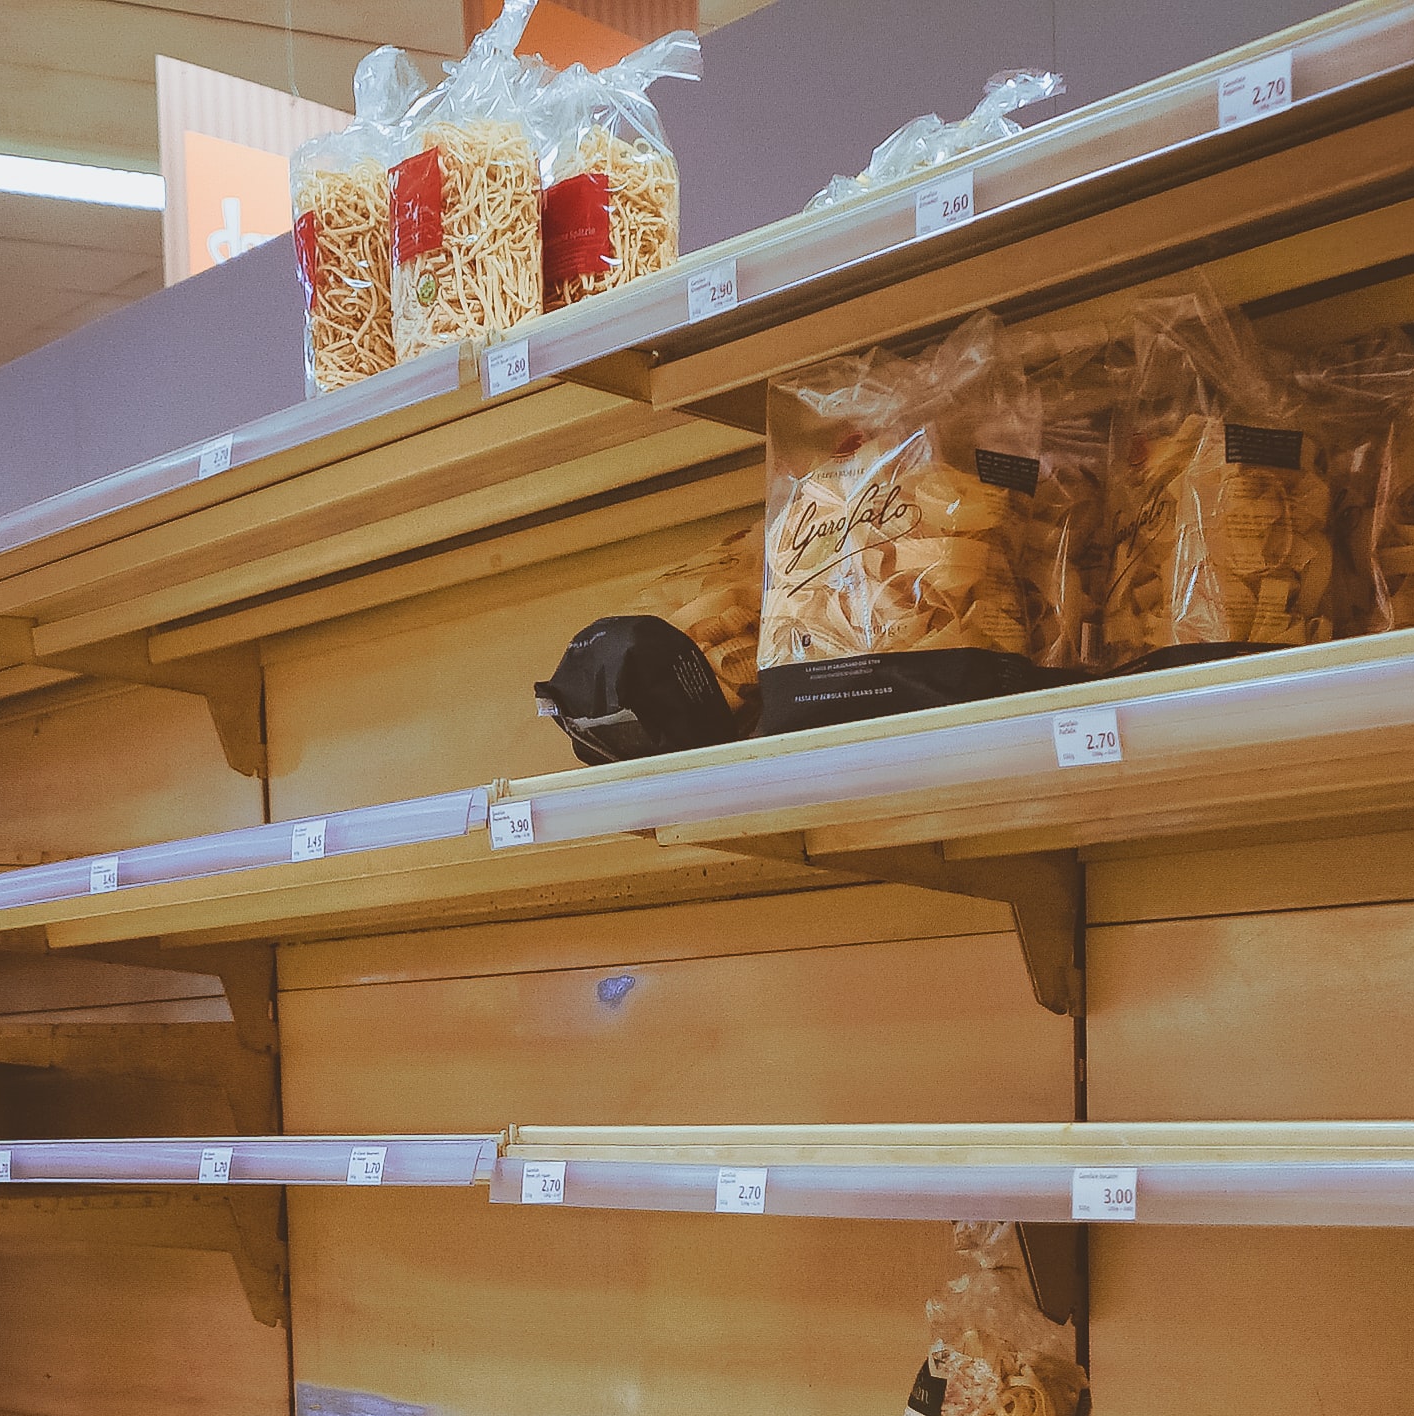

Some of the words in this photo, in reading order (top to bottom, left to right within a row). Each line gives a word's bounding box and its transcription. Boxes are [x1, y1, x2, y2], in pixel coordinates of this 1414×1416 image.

[1252, 77, 1285, 105] 2.70
[942, 193, 968, 217] 2.60
[710, 280, 733, 302] 2.90
[507, 357, 526, 377] 2.80
[785, 484, 921, 590] Garofalo
[1086, 731, 1116, 750] 2.70
[510, 818, 529, 833] 3.90
[542, 1179, 561, 1192] 2.70
[738, 1185, 761, 1199] 2.70
[1103, 1188, 1133, 1204] 3.00
